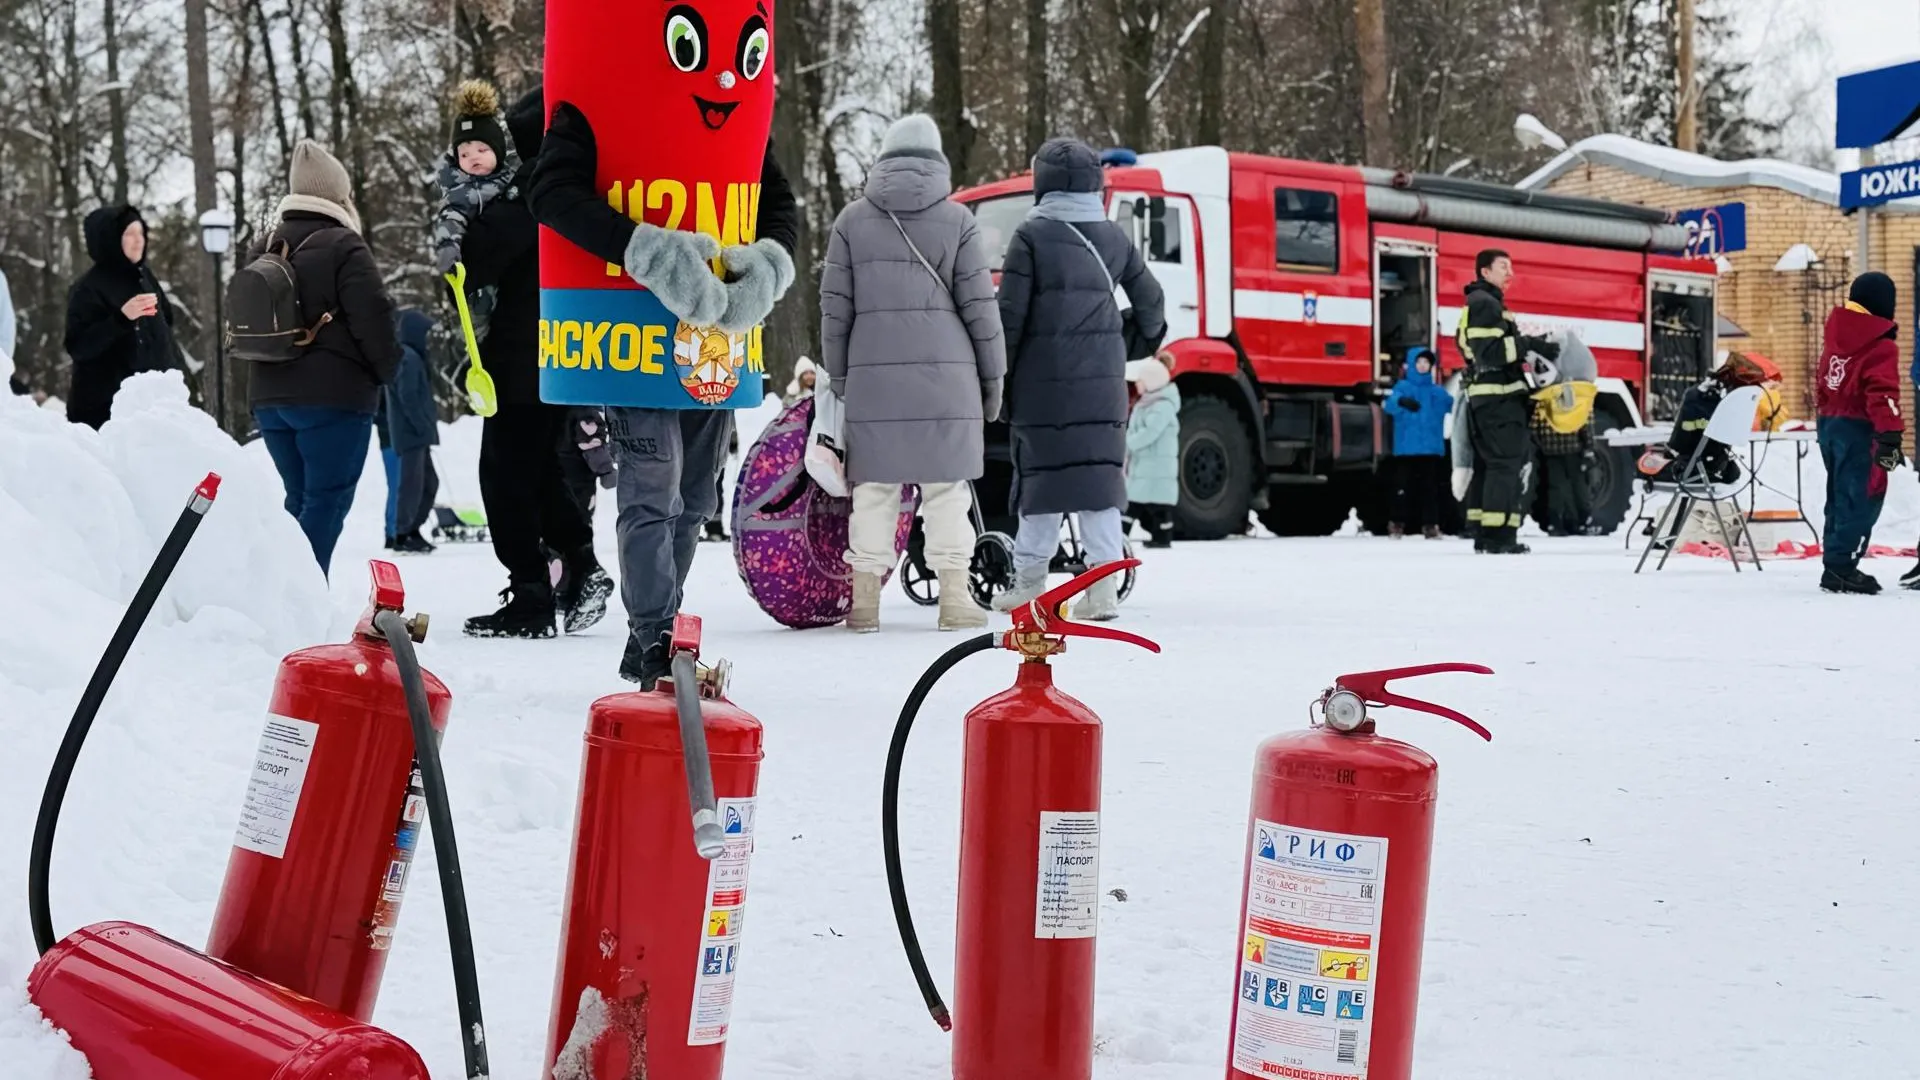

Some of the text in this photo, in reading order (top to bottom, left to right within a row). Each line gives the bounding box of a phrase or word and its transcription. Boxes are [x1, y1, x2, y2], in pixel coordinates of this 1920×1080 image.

[1056, 856, 1094, 866] ПАСПОРТ
[1279, 981, 1287, 992] B
[1315, 988, 1325, 999] C
[1354, 993, 1363, 1003] E
